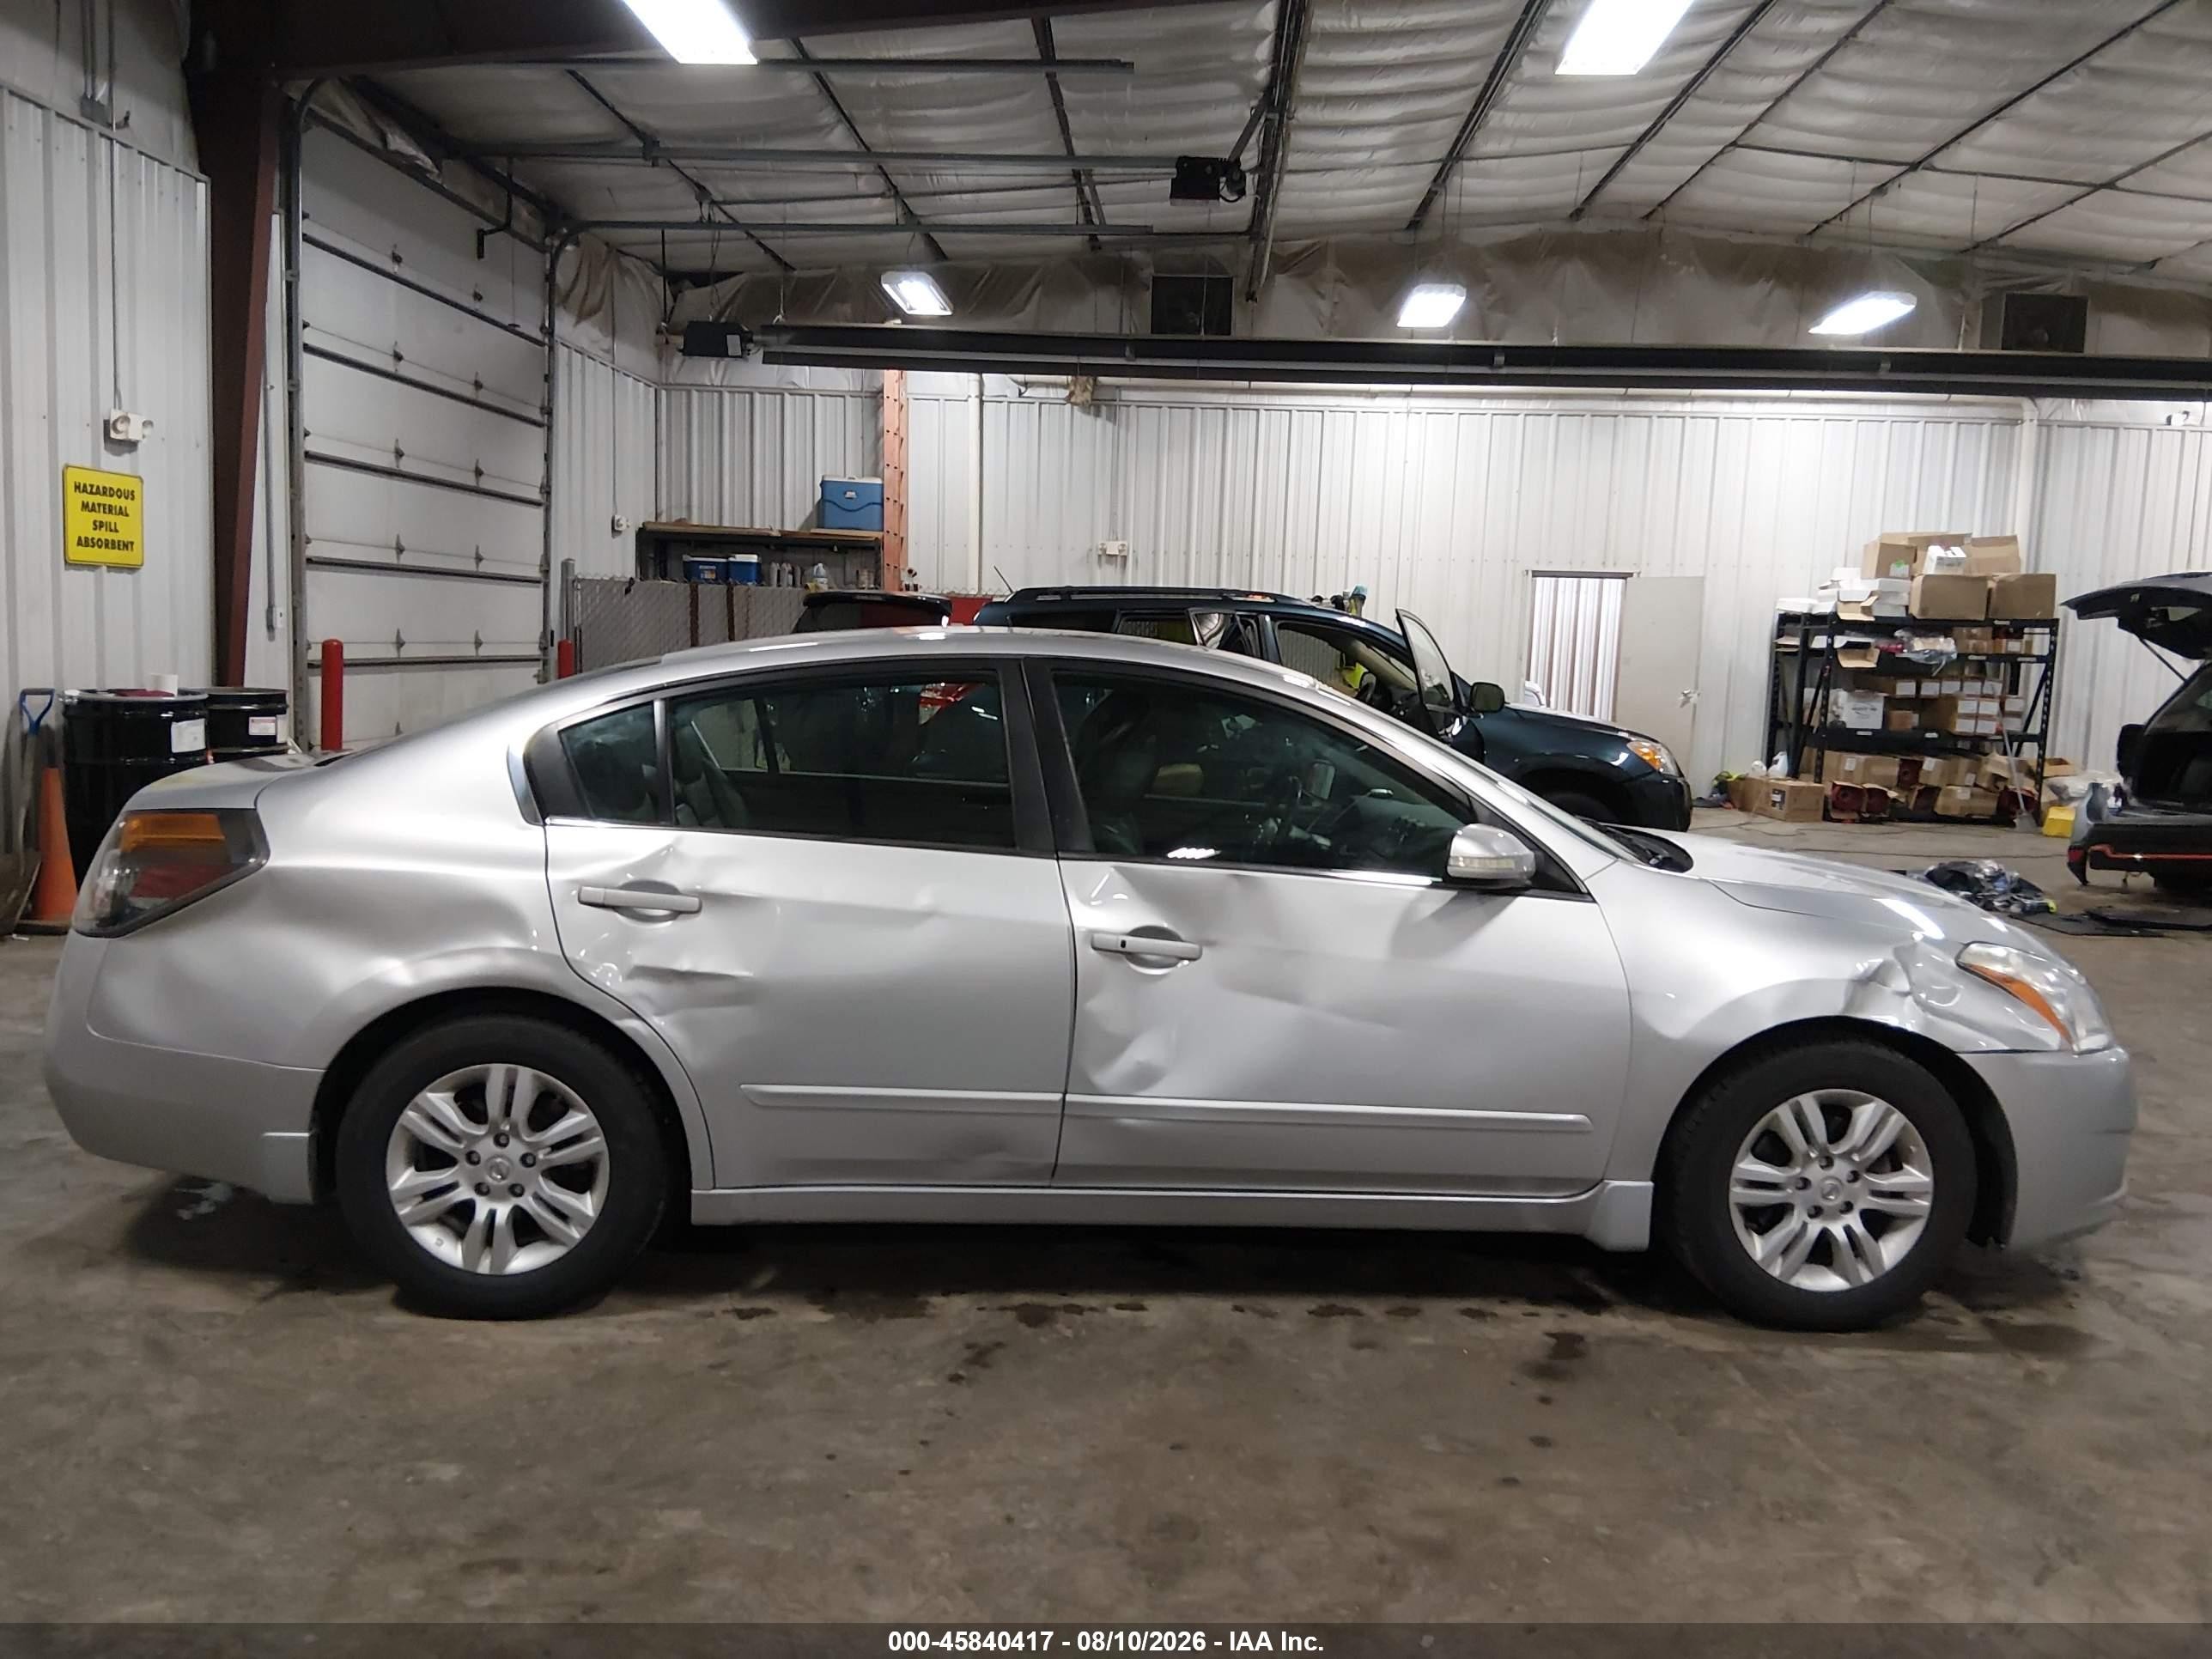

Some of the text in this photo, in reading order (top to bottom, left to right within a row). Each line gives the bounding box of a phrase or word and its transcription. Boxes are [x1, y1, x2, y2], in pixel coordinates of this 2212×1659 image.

[74, 481, 135, 501] HAZARDOUS
[81, 501, 130, 517] MATERIAL
[92, 520, 119, 533] SPILL
[76, 536, 134, 551] ABSORBENT
